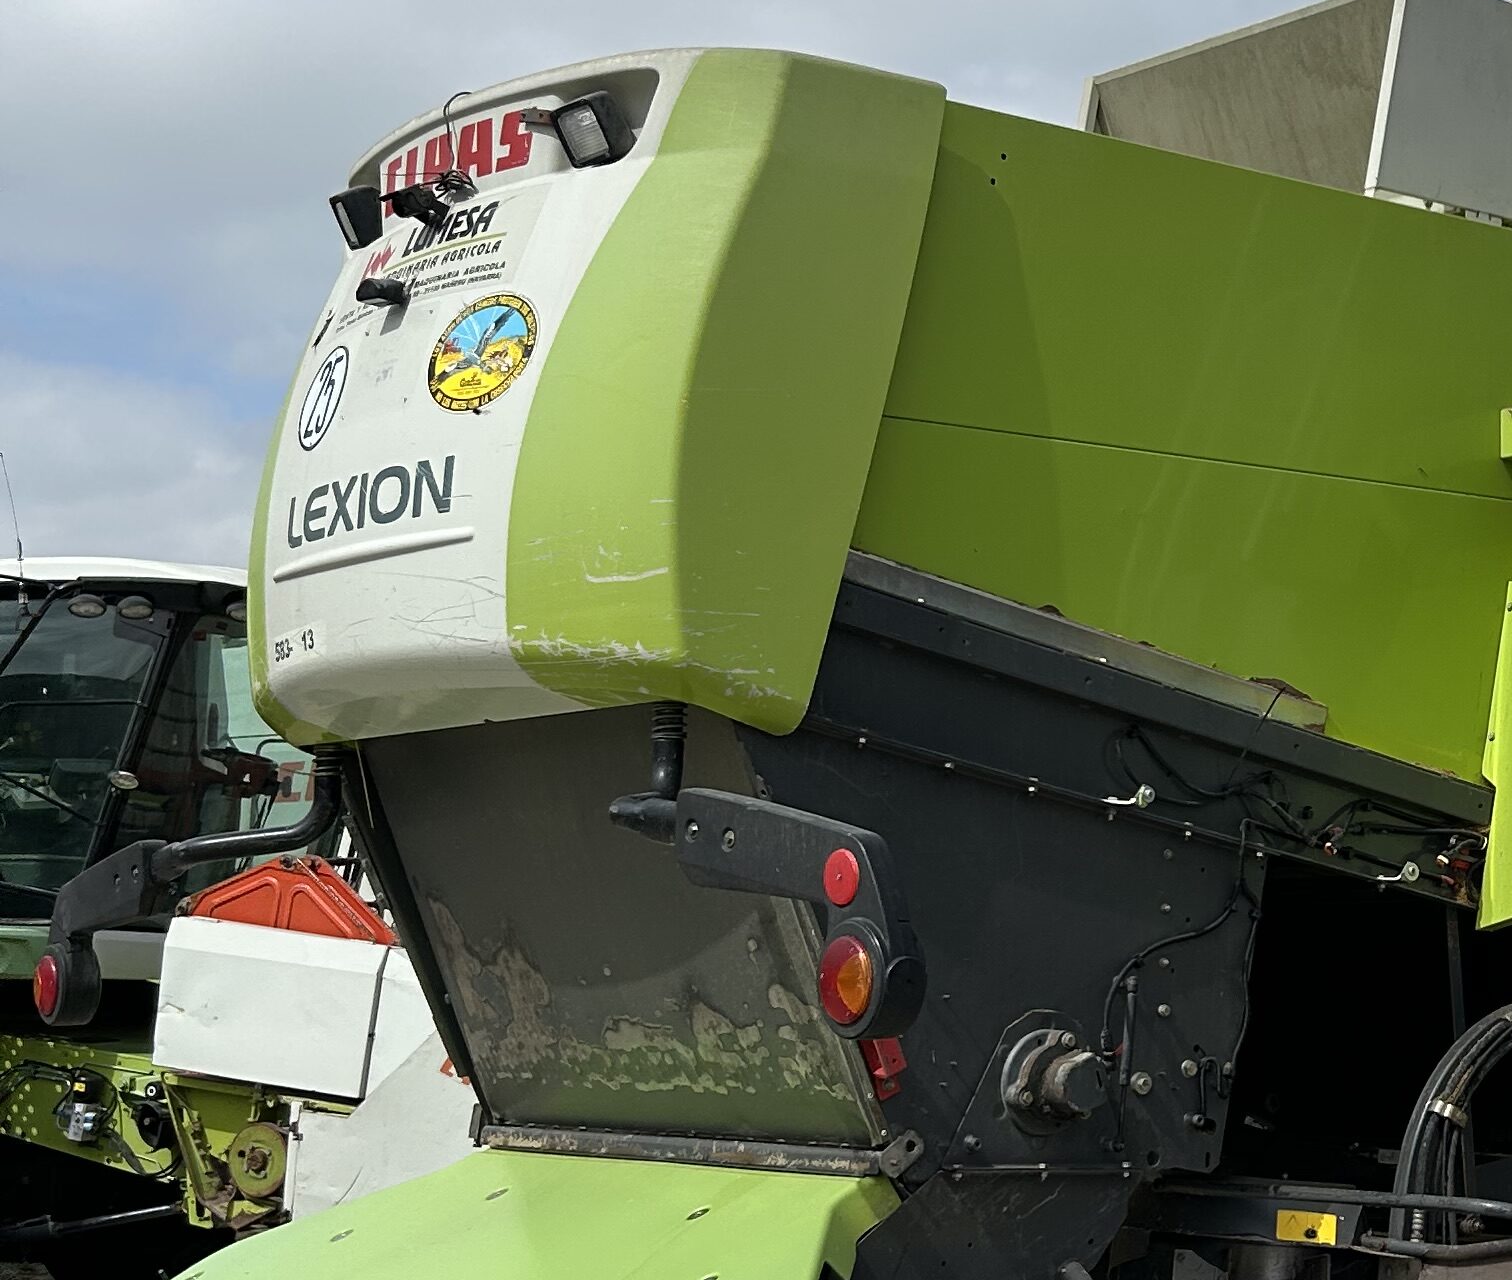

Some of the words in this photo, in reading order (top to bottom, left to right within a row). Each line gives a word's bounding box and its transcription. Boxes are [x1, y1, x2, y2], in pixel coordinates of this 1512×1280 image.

[401, 201, 500, 258] LUMESA
[441, 240, 502, 265] AGRICOLA
[303, 354, 345, 439] 25
[287, 455, 455, 549] LEXION
